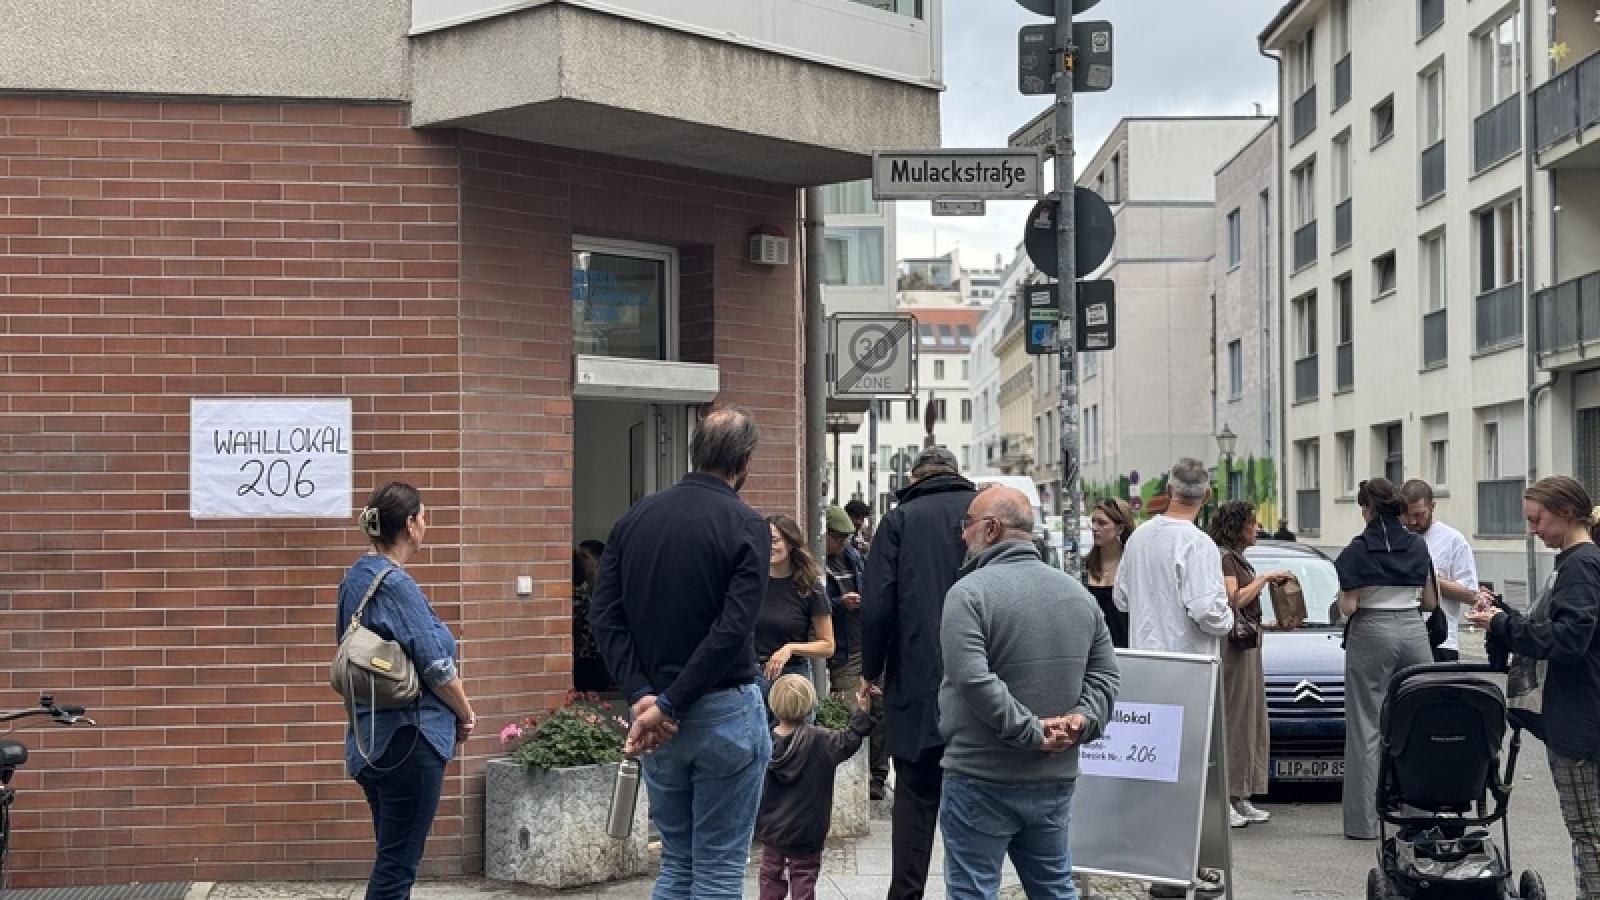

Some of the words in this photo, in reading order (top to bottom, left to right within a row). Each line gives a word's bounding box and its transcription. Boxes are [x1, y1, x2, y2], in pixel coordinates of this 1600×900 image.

[890, 159, 1026, 188] Mulackstraße
[213, 425, 348, 454] WAHLLOKAL
[237, 458, 315, 498] 206
[1115, 709, 1151, 725] llokal
[1126, 744, 1157, 762] 206
